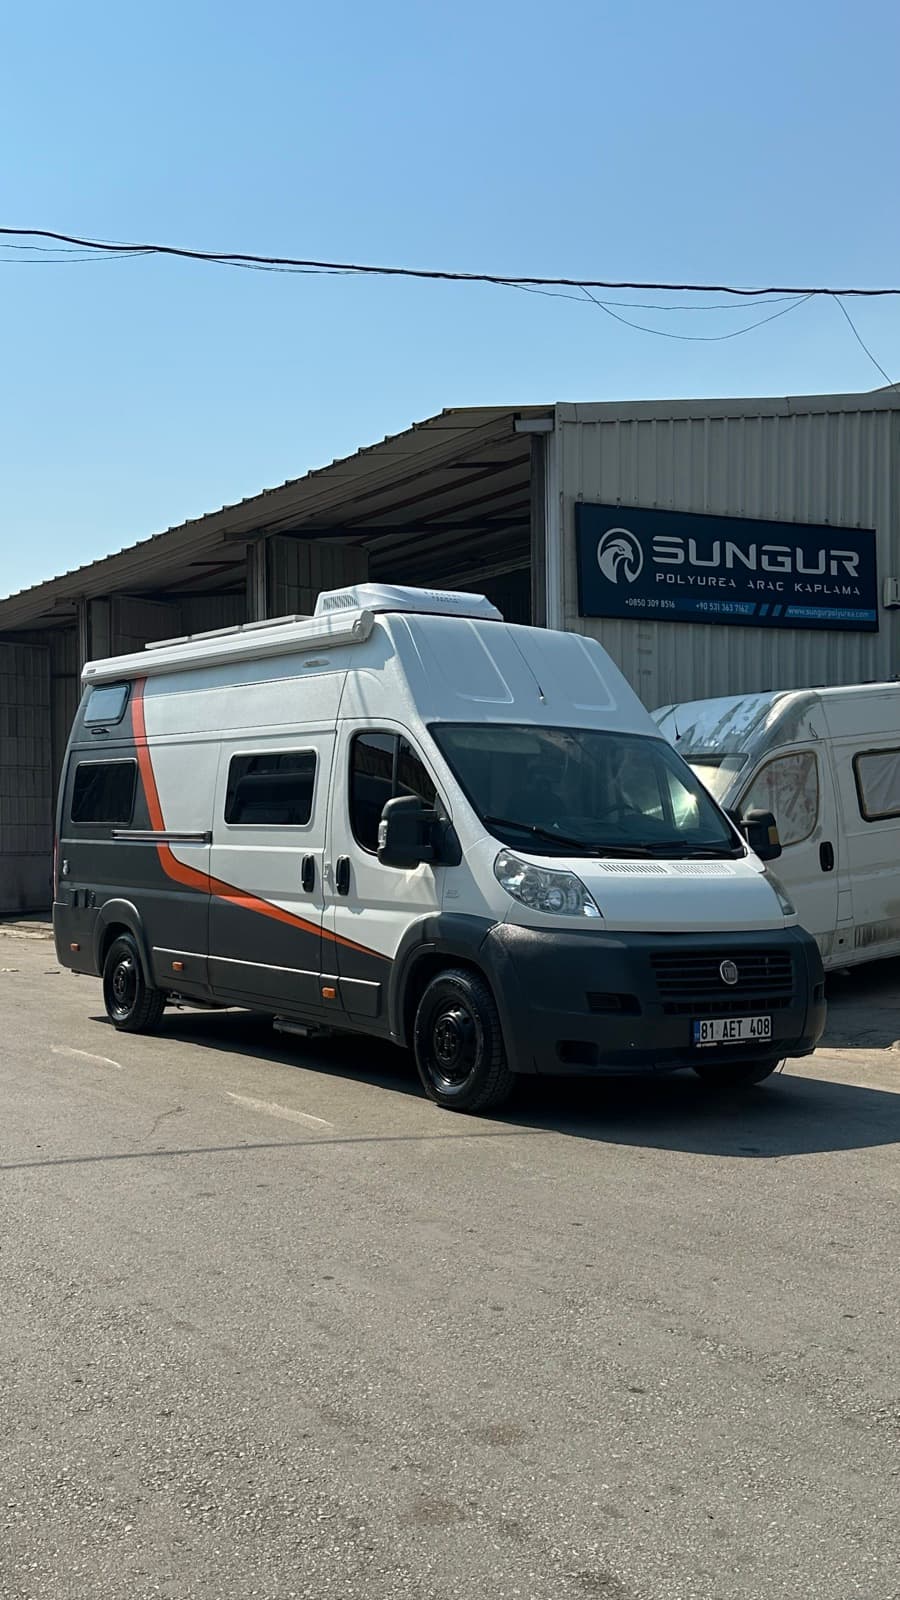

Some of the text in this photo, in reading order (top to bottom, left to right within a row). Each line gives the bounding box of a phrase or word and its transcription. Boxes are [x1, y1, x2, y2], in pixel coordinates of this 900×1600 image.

[652, 535, 860, 577] SUNGUR
[656, 573, 736, 587] POLYUREA
[794, 583, 861, 596] KAPLAMA
[701, 1022, 714, 1039] 81
[722, 1020, 743, 1038] AET
[750, 1018, 769, 1036] 408
